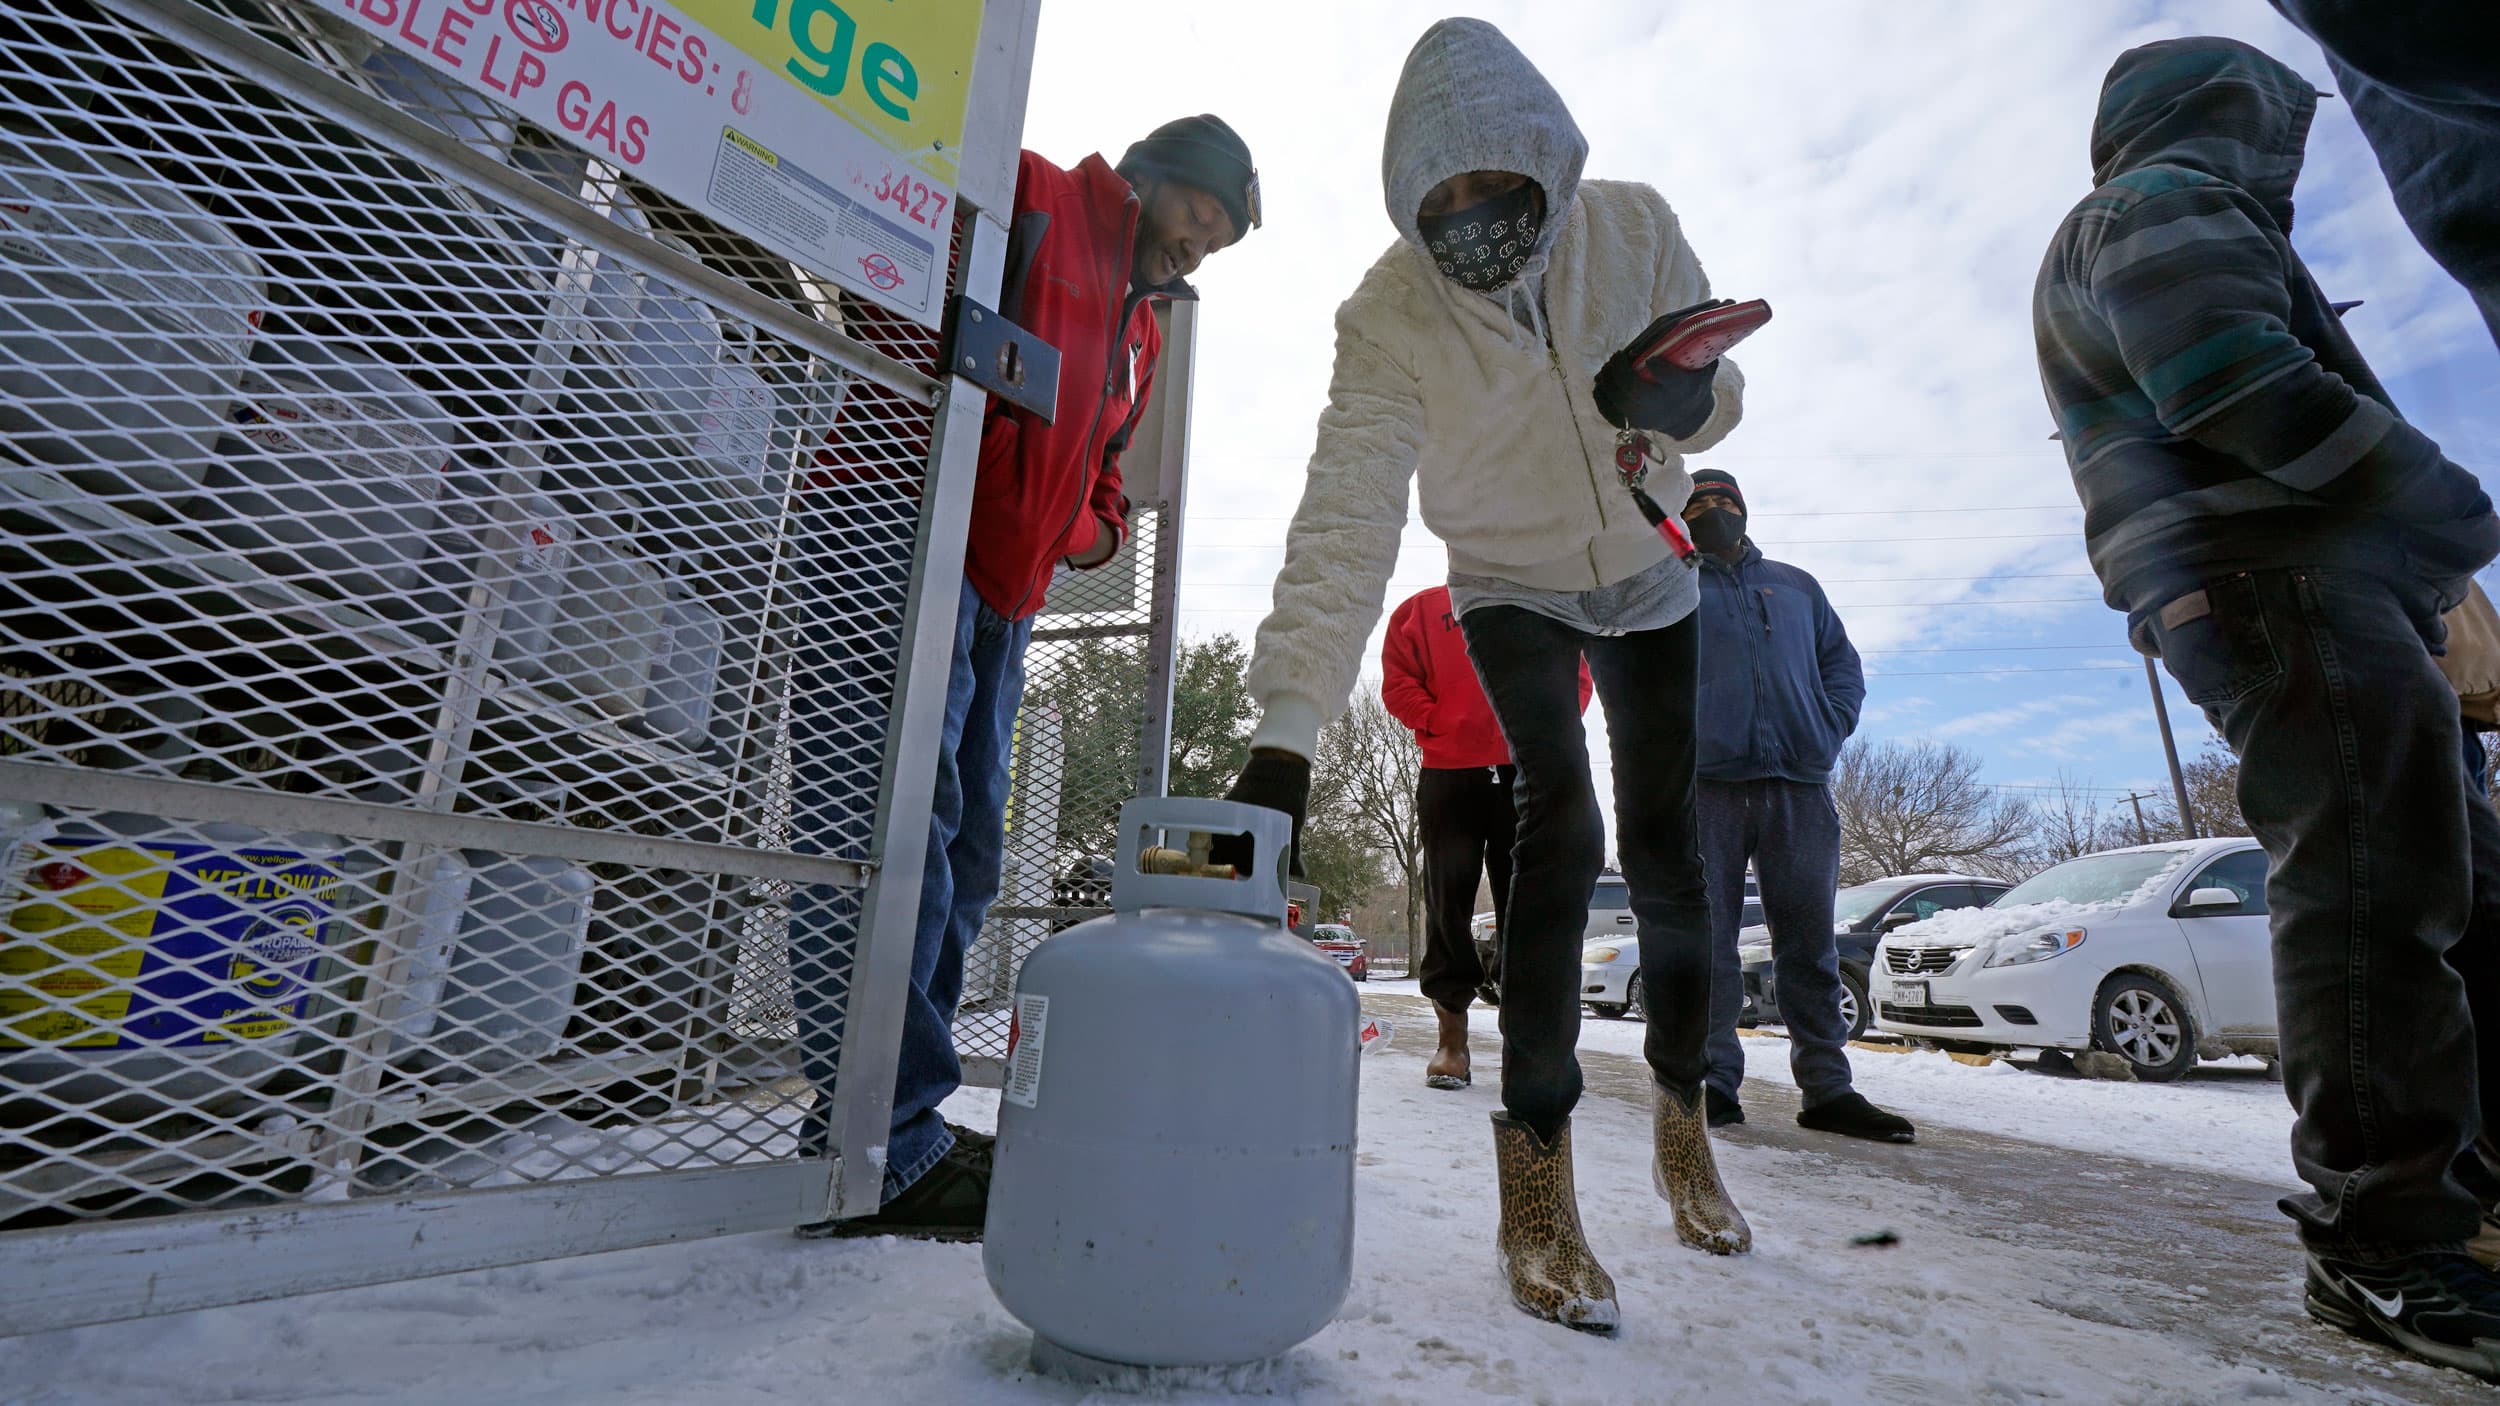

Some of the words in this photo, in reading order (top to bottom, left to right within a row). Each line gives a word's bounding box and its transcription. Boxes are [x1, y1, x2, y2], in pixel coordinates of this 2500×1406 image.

[480, 34, 547, 99] LP
[556, 80, 650, 165] GAS
[736, 134, 775, 164] WARNING
[197, 868, 315, 899] YELLOW
